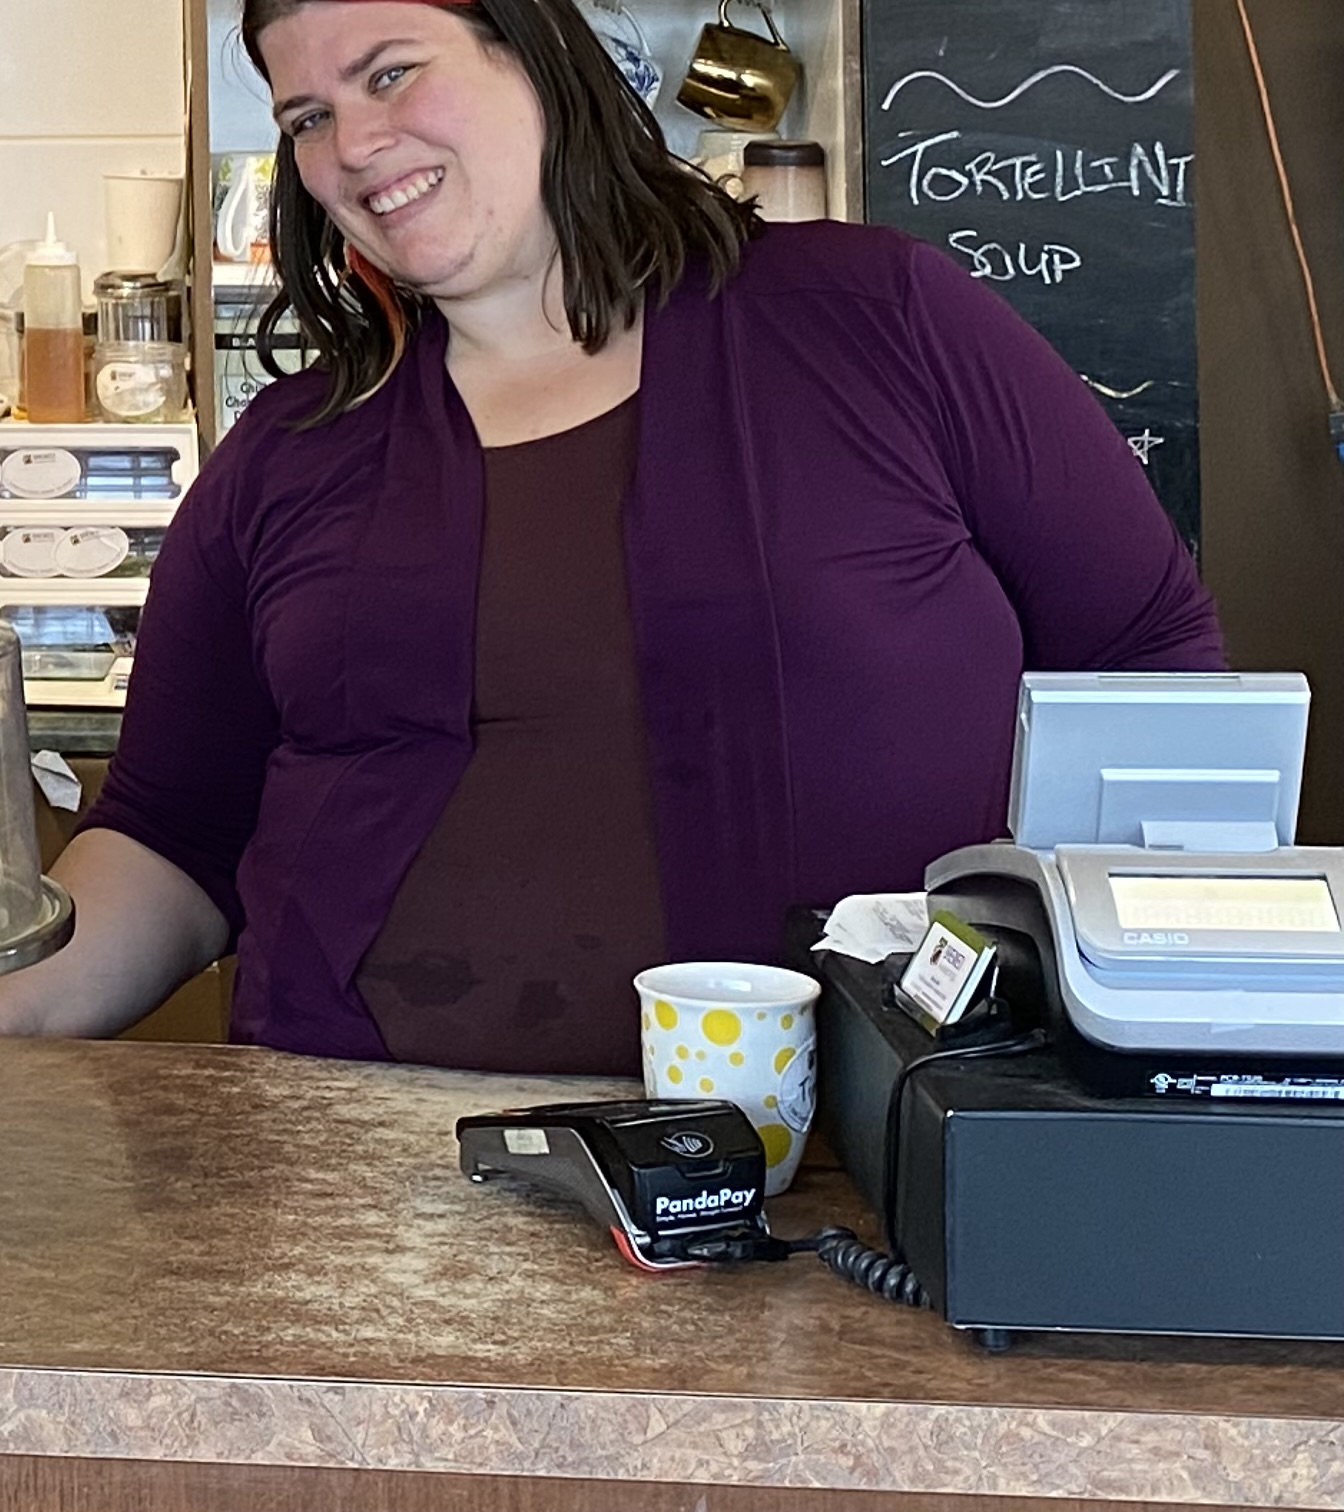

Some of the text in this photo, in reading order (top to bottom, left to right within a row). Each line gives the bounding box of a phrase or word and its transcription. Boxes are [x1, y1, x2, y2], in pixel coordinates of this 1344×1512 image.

[948, 230, 1081, 283] SOUP
[1123, 933, 1189, 945] CASIO
[656, 1188, 756, 1214] PandaPay
